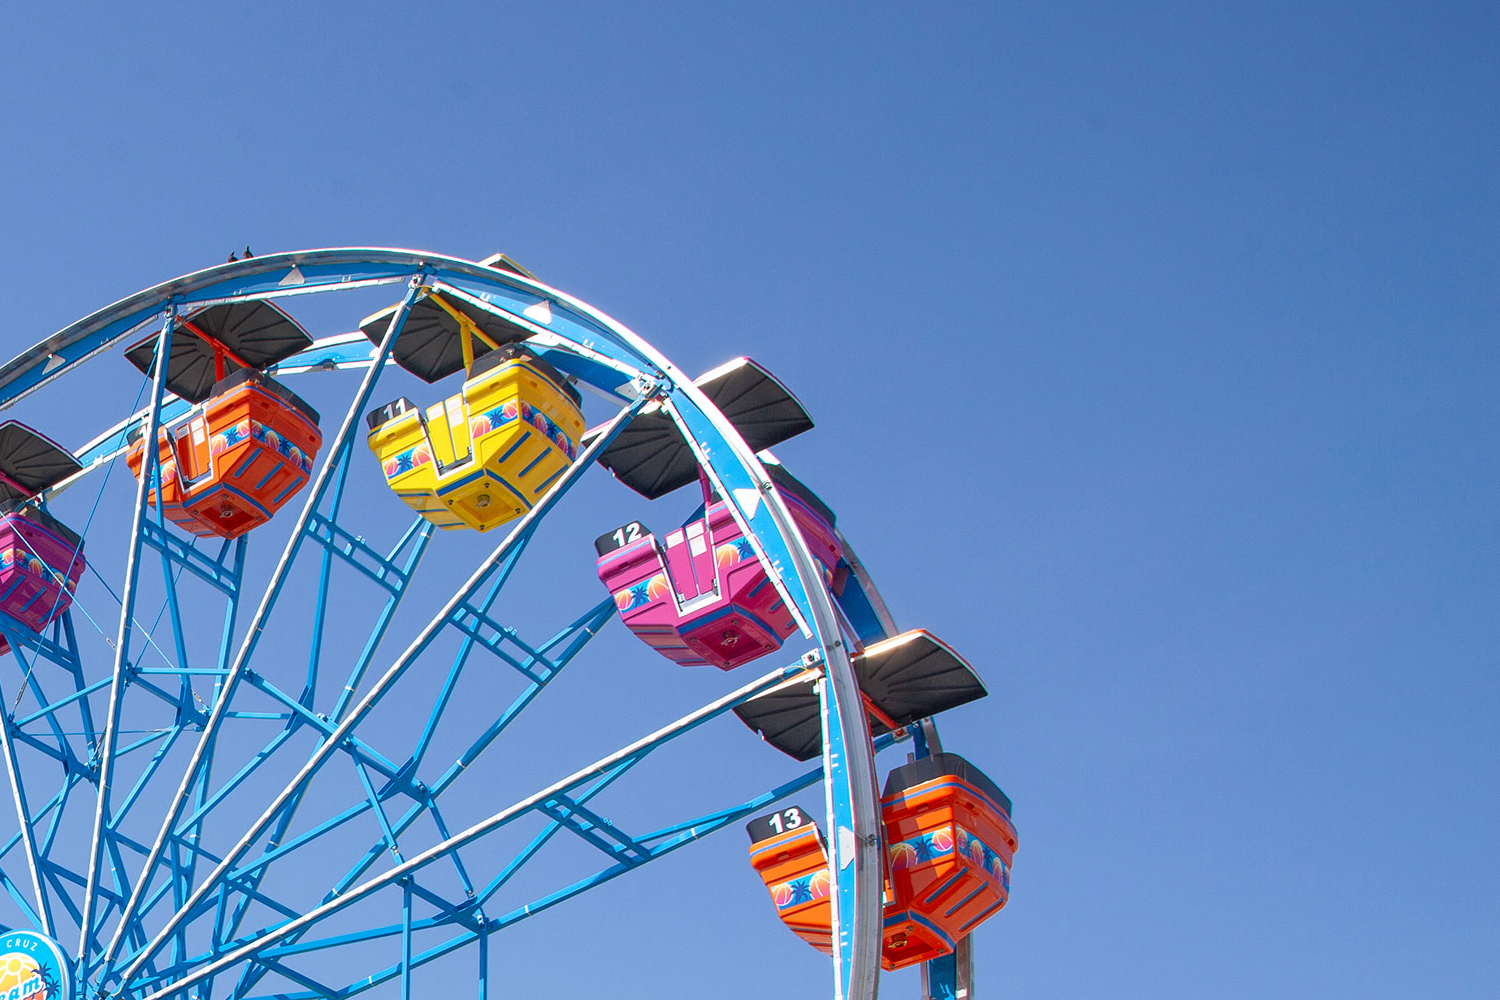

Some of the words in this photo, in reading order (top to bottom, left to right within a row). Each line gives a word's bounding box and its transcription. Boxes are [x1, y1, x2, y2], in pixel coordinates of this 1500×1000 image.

[383, 397, 407, 420] 11
[612, 522, 643, 549] 12
[768, 807, 802, 834] 13
[6, 938, 39, 952] CRUZ
